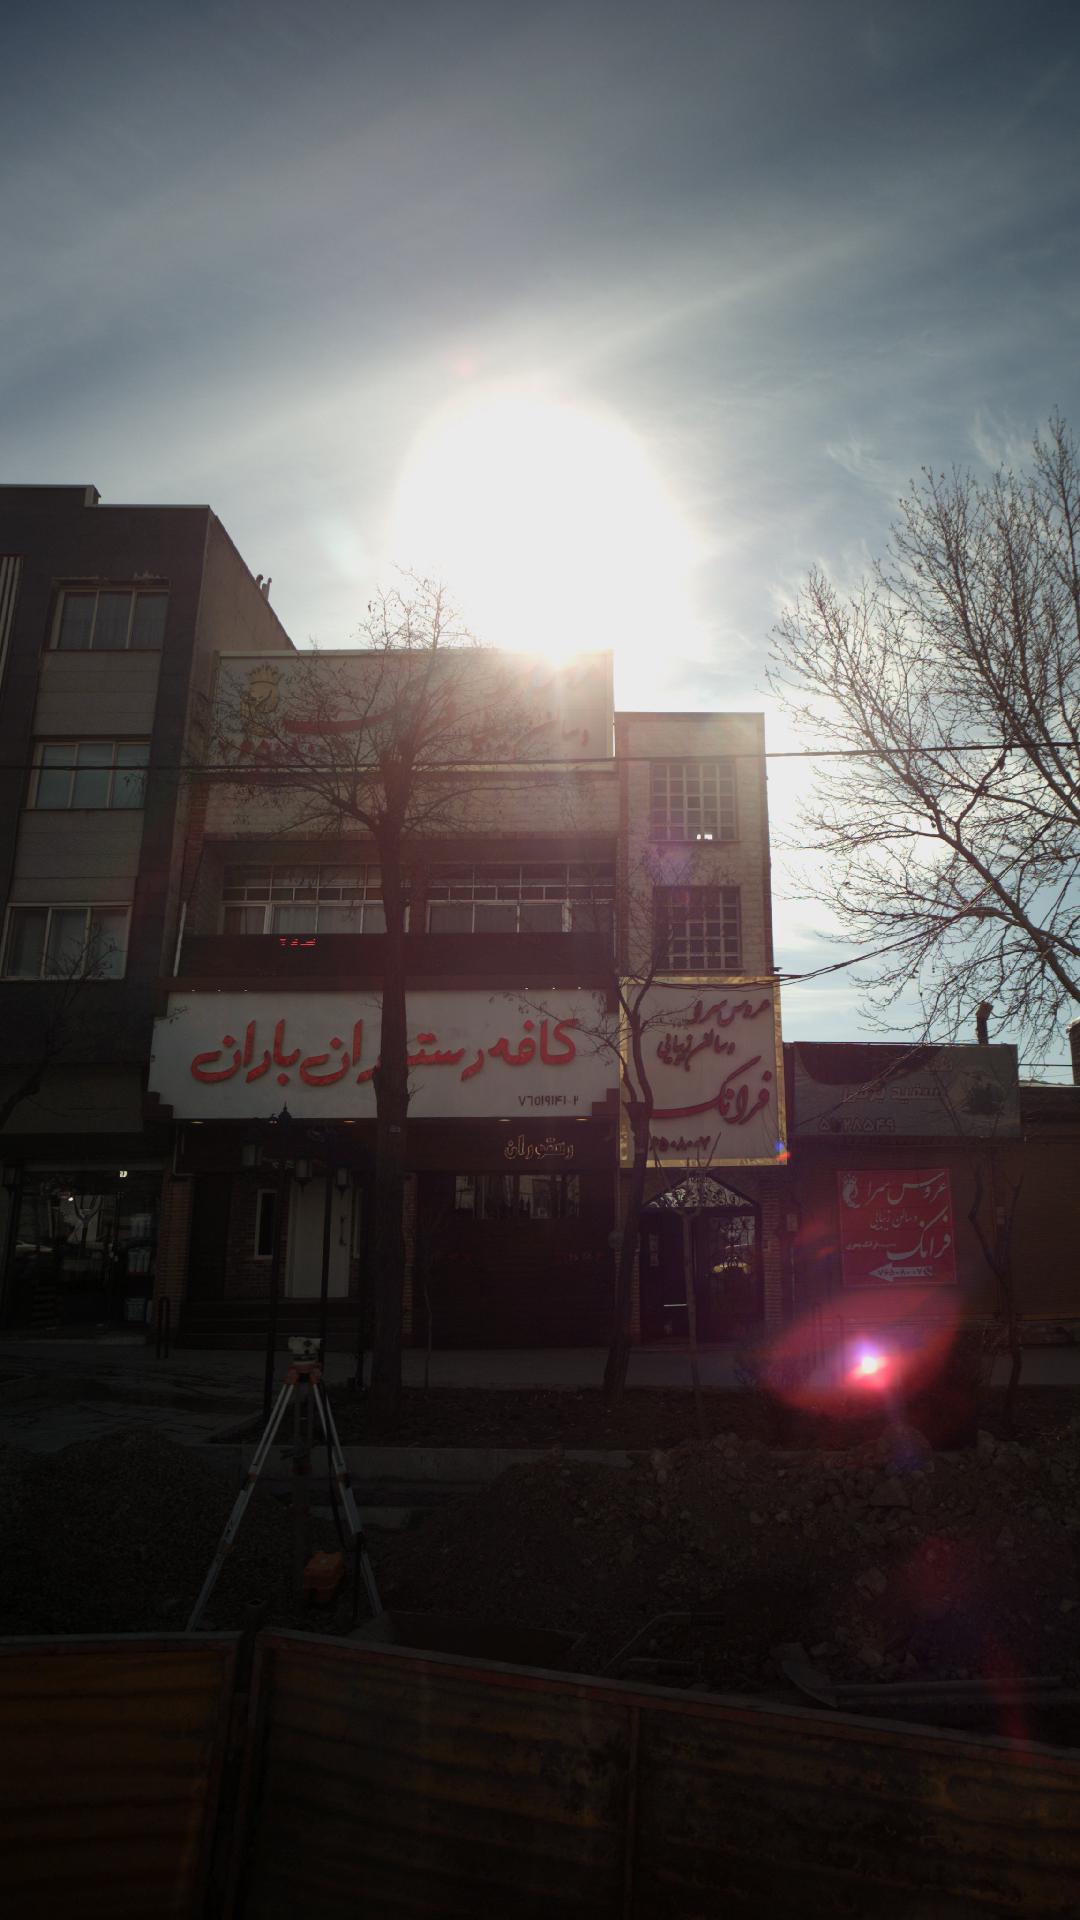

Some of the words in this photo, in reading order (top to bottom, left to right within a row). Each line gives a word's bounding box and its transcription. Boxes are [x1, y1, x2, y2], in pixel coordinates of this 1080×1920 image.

[190, 1019, 301, 1085] باران
[298, 1019, 485, 1087] رستران
[488, 1017, 580, 1066] کافه
[503, 1133, 577, 1161] رستوران
[887, 1171, 951, 1206] عروس
[886, 1205, 952, 1261] فرانک
